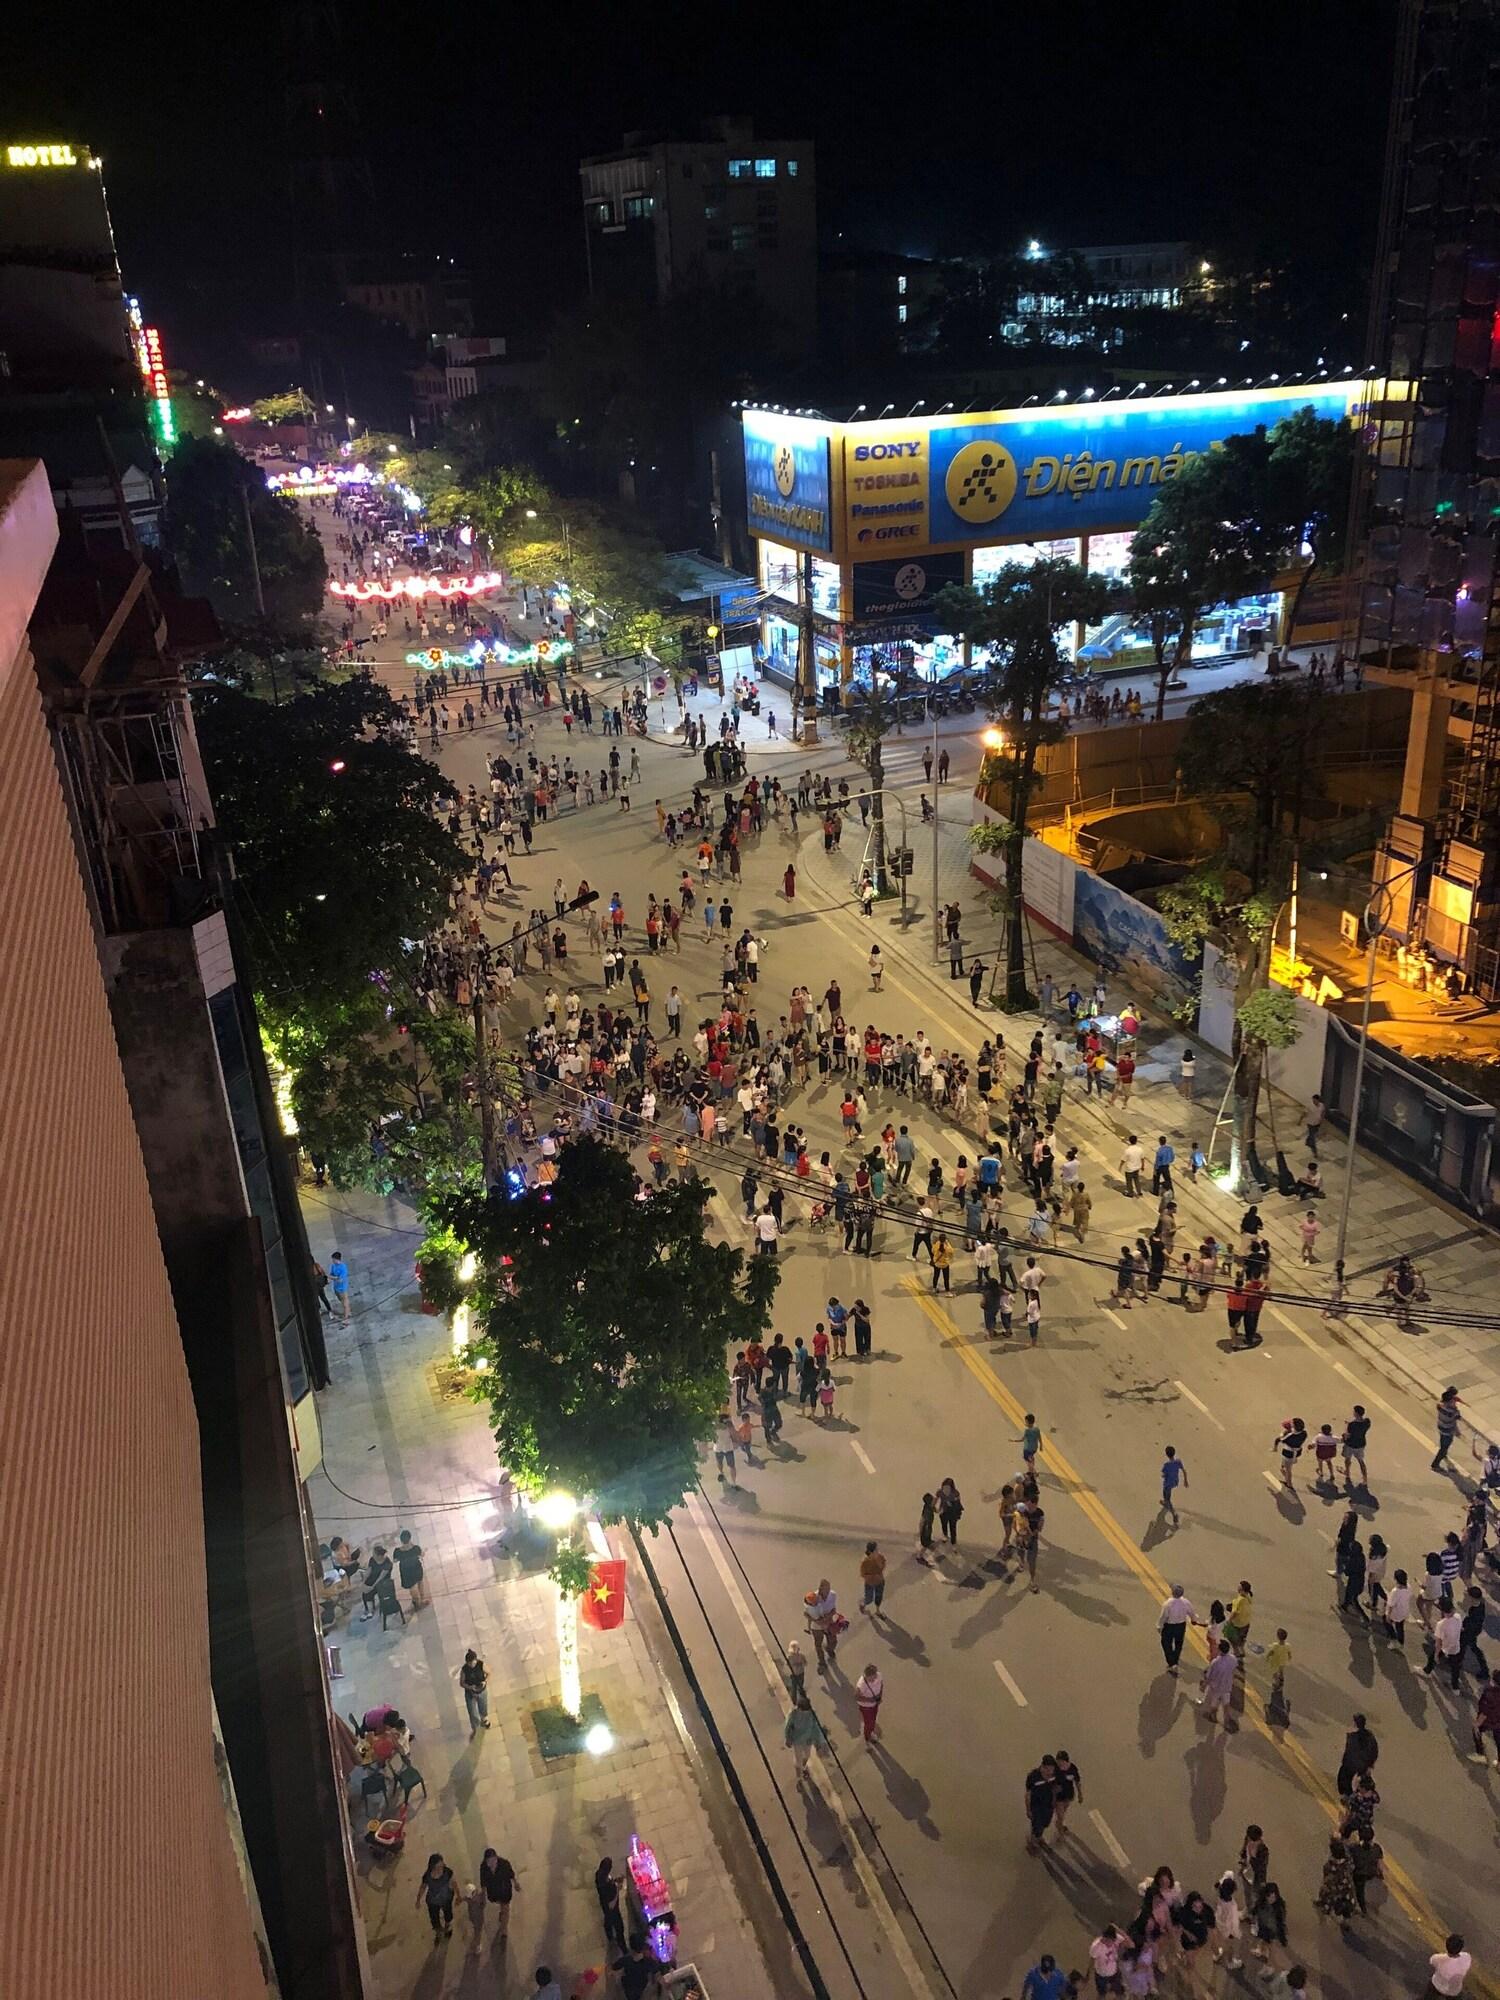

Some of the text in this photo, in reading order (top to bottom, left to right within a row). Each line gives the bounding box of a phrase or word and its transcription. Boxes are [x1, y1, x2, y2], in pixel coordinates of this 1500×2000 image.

[7, 145, 77, 167] HOTEL
[854, 441, 921, 461] SONY
[854, 472, 920, 491] TOSHIBA
[1023, 451, 1117, 499] Điện
[852, 499, 924, 518] Panasonic
[875, 524, 921, 540] GREE
